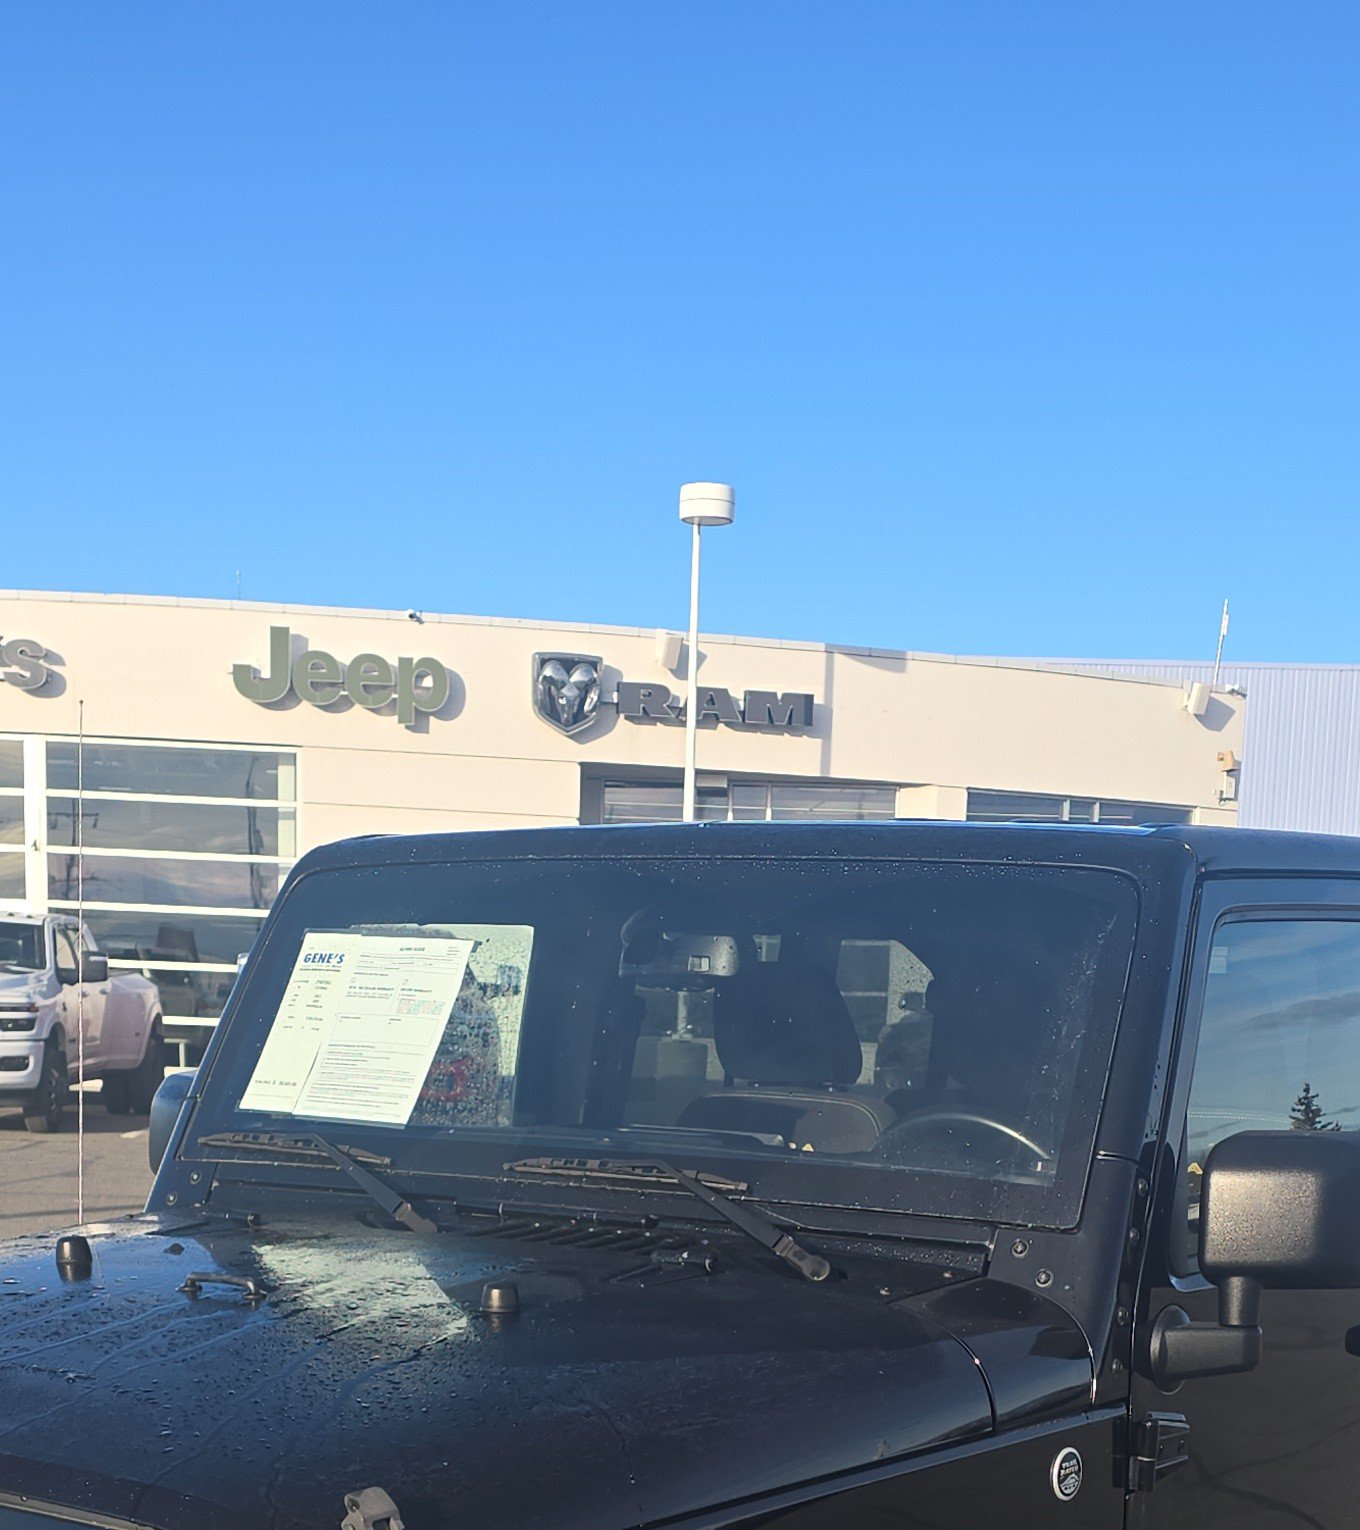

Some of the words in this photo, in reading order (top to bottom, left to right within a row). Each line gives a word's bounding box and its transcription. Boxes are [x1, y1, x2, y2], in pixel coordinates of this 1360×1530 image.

[230, 625, 451, 725] Jeep
[616, 680, 814, 727] RAM
[303, 952, 345, 964] GENE'S
